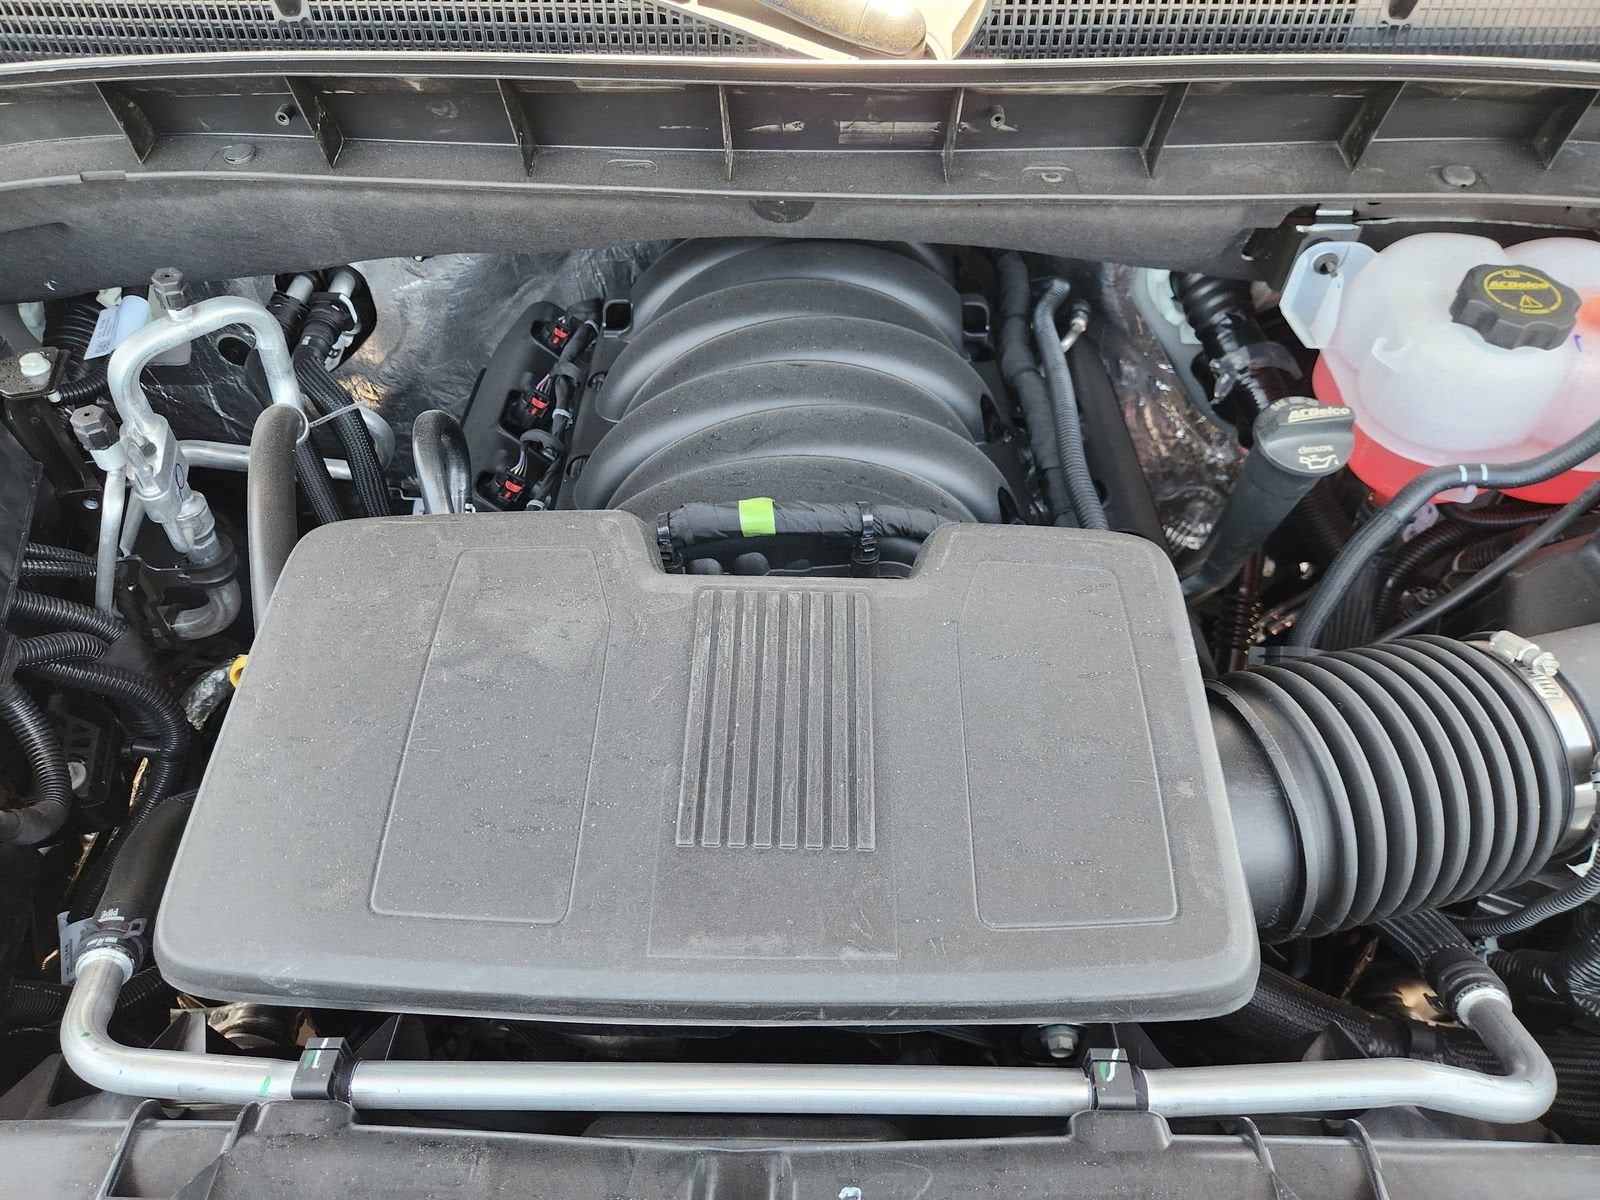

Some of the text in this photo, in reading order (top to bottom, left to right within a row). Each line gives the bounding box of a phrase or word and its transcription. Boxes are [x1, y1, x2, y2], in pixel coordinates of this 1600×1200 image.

[1488, 280, 1551, 290] ACDelco
[1287, 406, 1350, 423] ACDelco
[101, 908, 119, 918] PIPE
